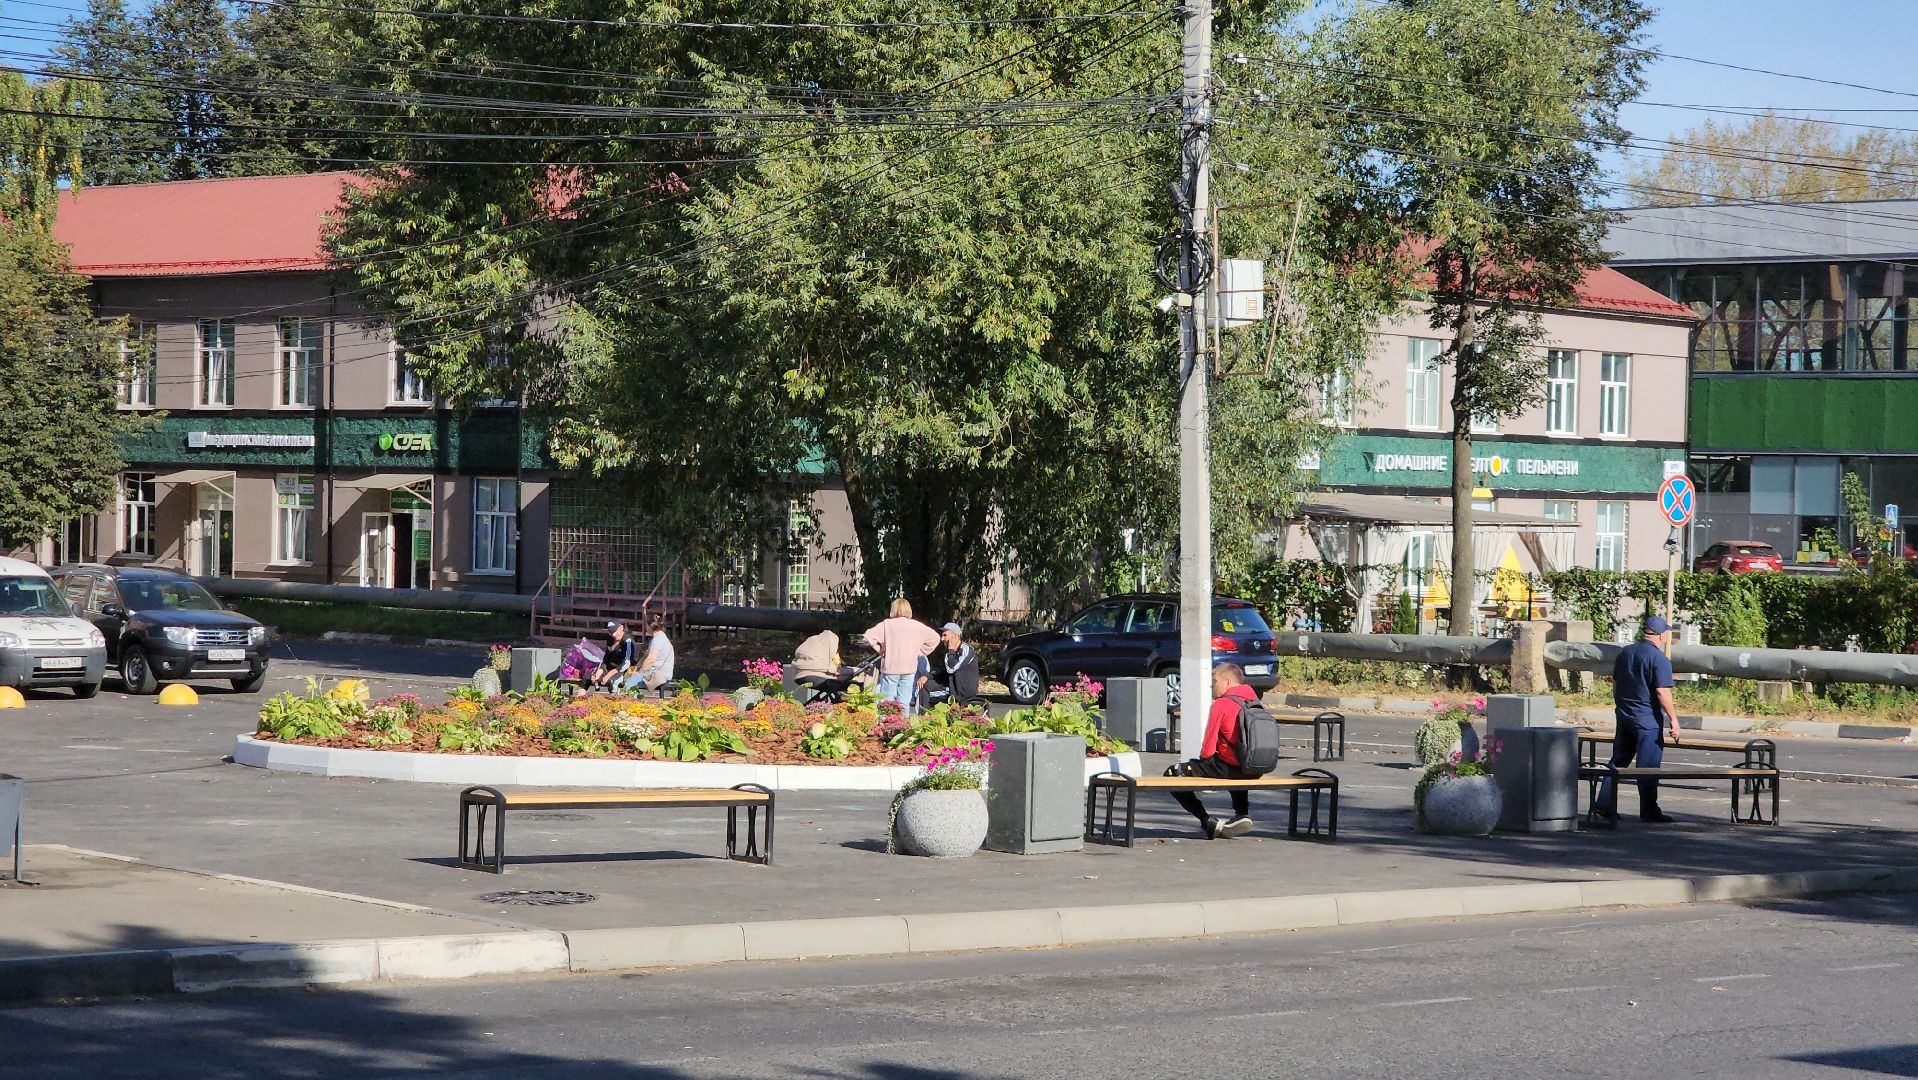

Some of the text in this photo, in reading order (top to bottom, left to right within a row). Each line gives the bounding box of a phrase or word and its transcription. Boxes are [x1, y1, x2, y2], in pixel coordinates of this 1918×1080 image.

[1374, 454, 1579, 477] ДОМАШНИЕ ЕЛТОК ПЕЛЬМЕНИ
